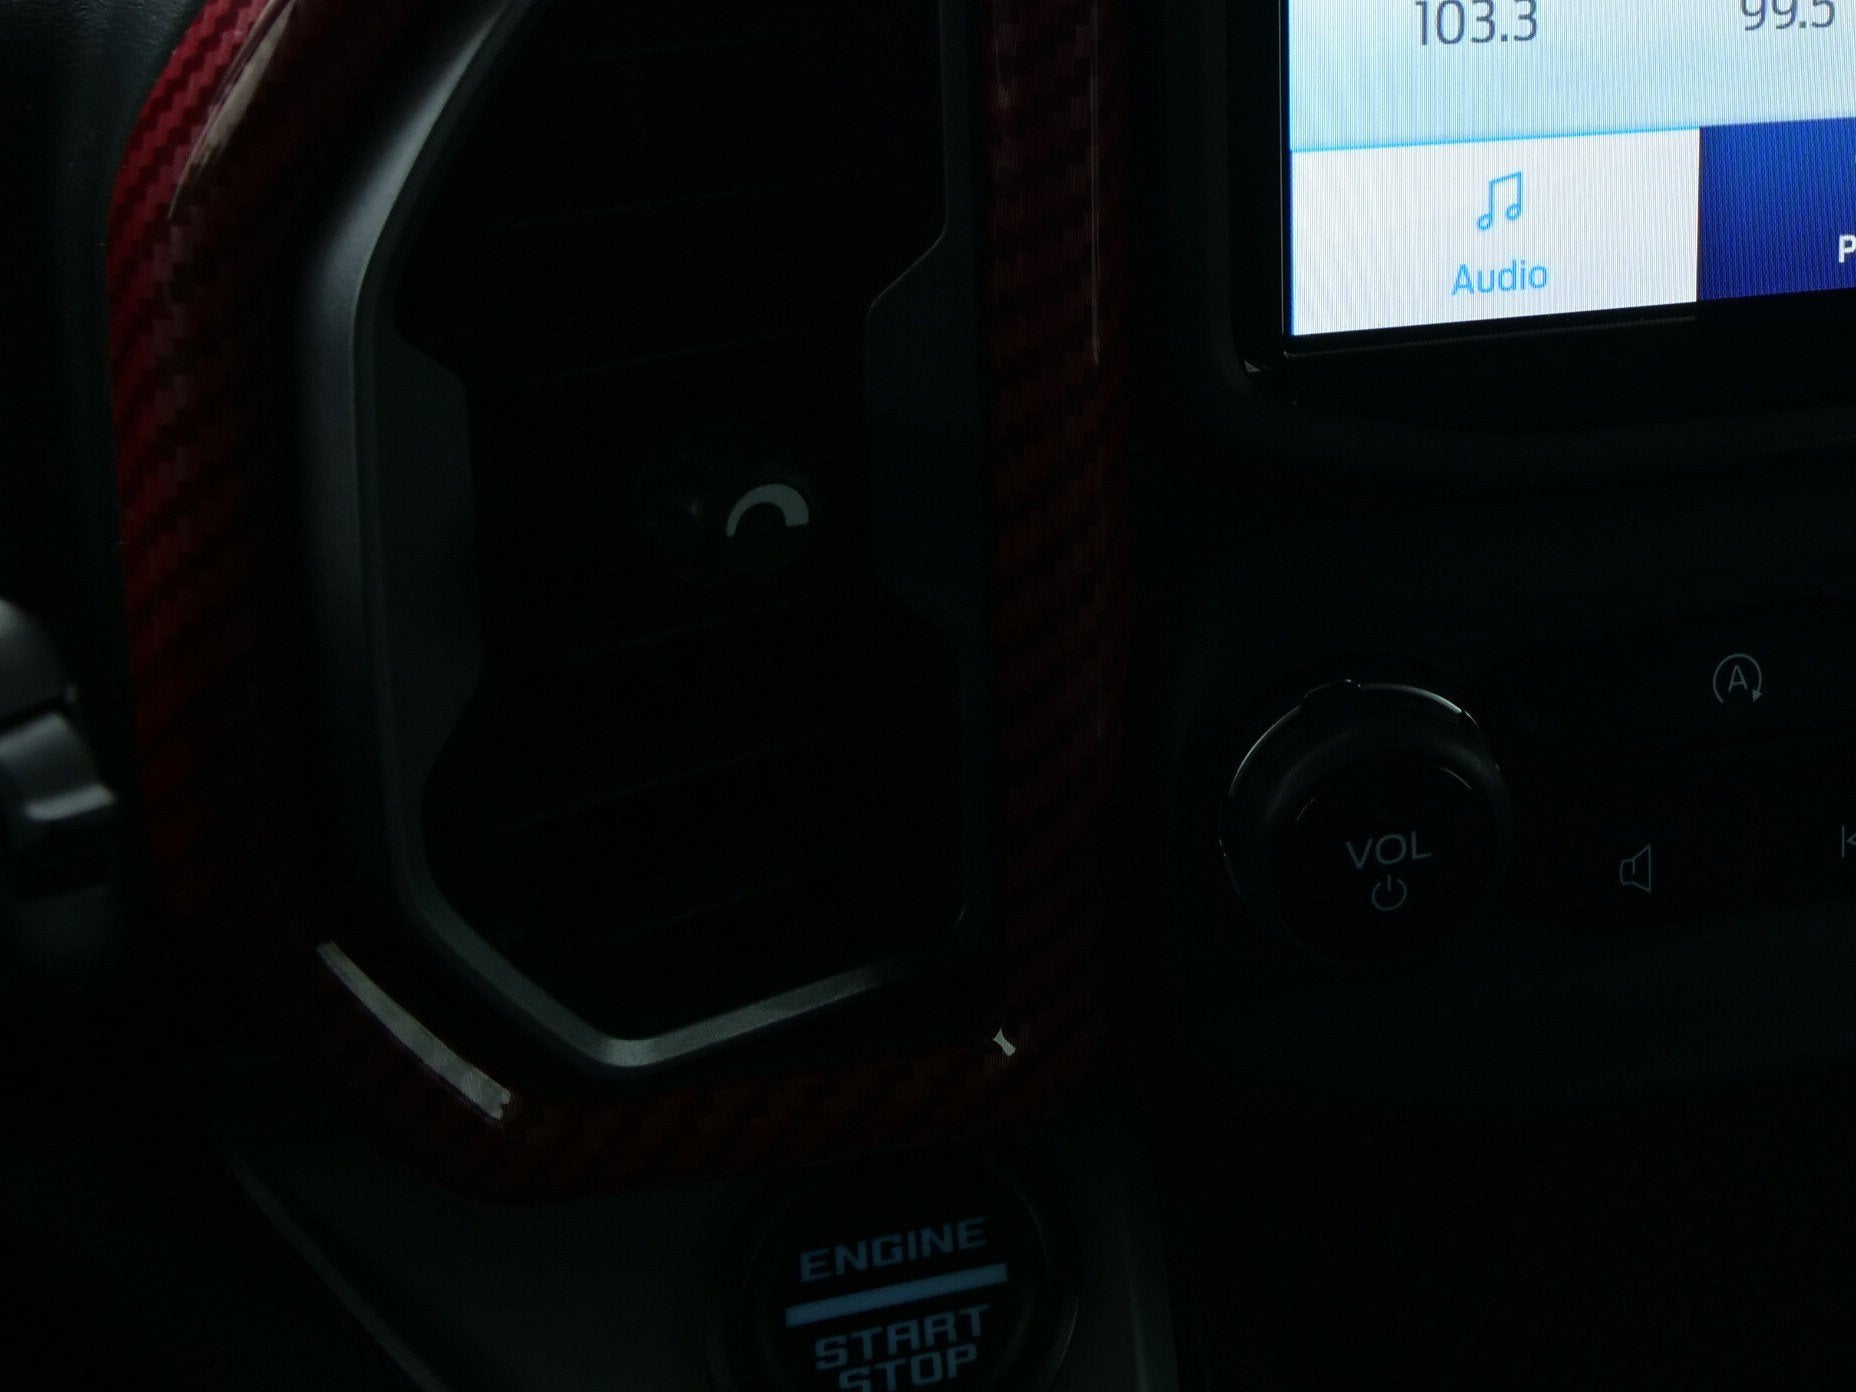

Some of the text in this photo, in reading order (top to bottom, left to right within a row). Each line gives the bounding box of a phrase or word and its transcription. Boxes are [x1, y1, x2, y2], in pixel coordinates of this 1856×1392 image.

[1451, 259, 1549, 296] Audio
[1344, 831, 1433, 873] VOL
[798, 1216, 990, 1283] ENGINE
[813, 1303, 992, 1373] START
[837, 1342, 980, 1392] STOP
